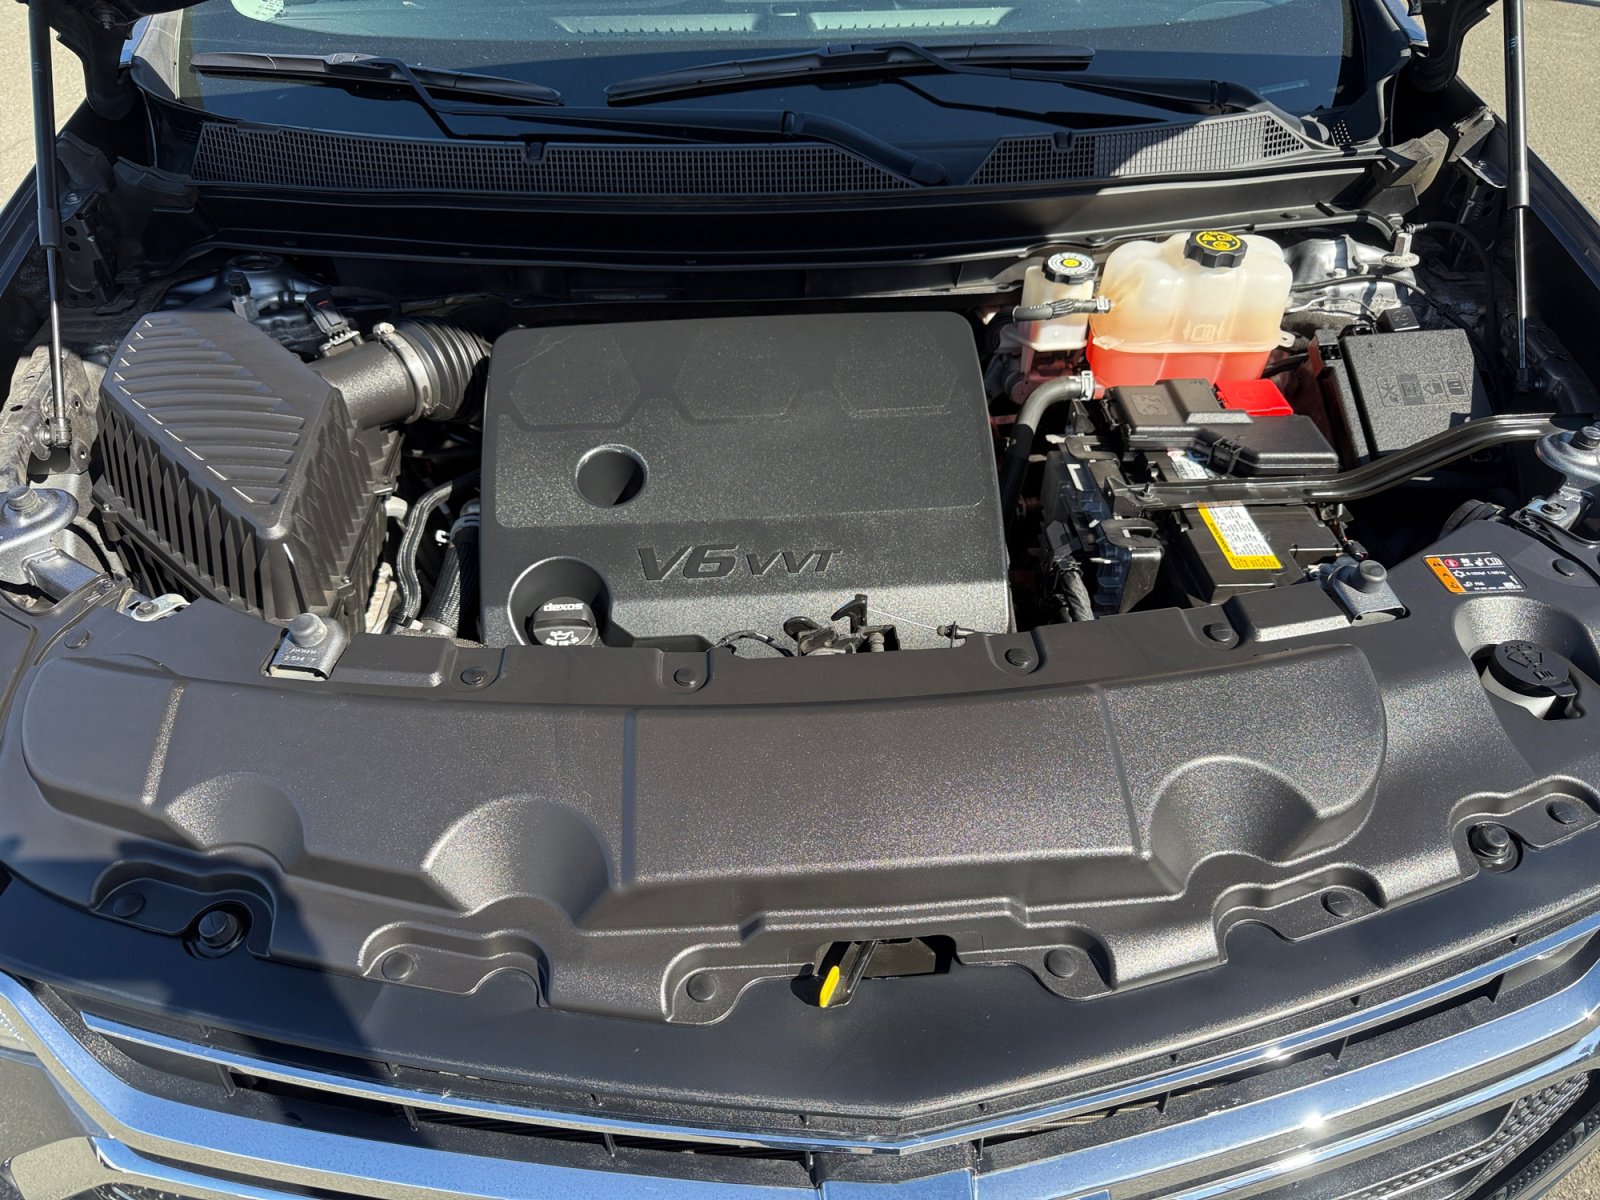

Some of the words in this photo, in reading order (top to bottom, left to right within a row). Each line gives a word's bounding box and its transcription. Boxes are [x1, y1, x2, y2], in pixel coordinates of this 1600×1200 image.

[637, 544, 738, 581] V6
[746, 549, 842, 576] VVT
[543, 602, 585, 612] dexos
